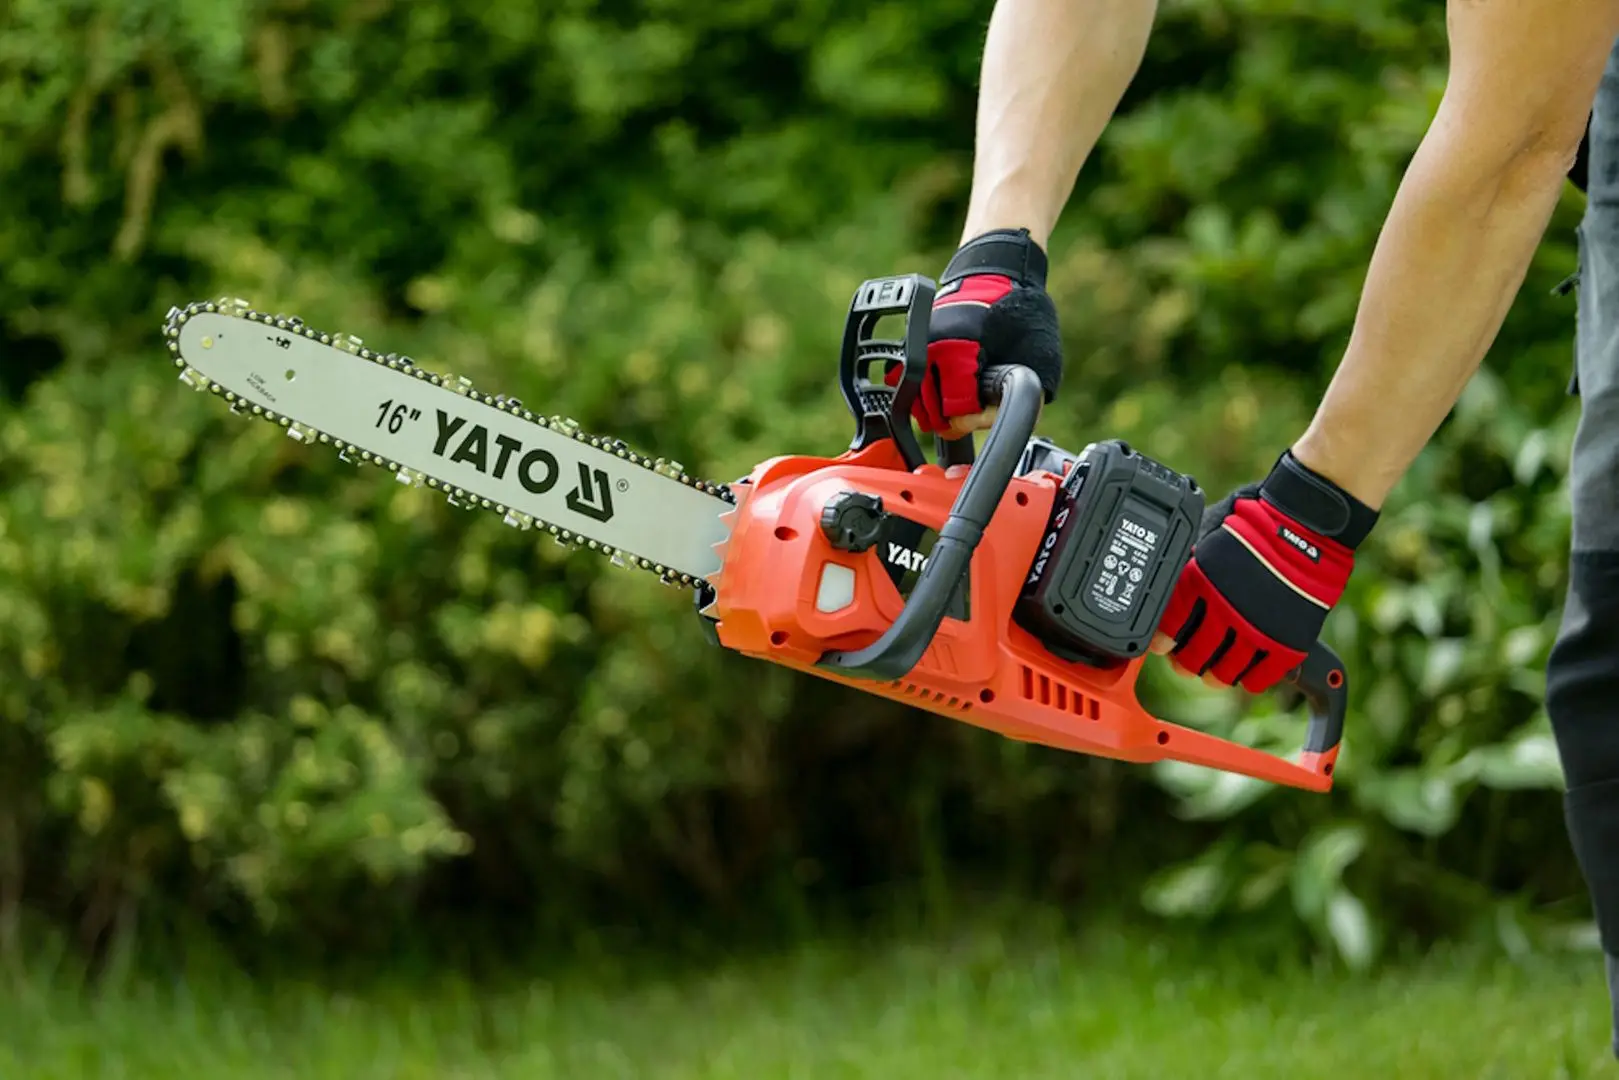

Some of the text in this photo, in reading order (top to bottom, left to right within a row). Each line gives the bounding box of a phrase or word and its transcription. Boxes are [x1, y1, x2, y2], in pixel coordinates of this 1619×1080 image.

[375, 399, 559, 494] 16" YATO
[1121, 518, 1146, 538] YATO
[1283, 528, 1308, 550] YATO
[1027, 532, 1058, 584] YATO
